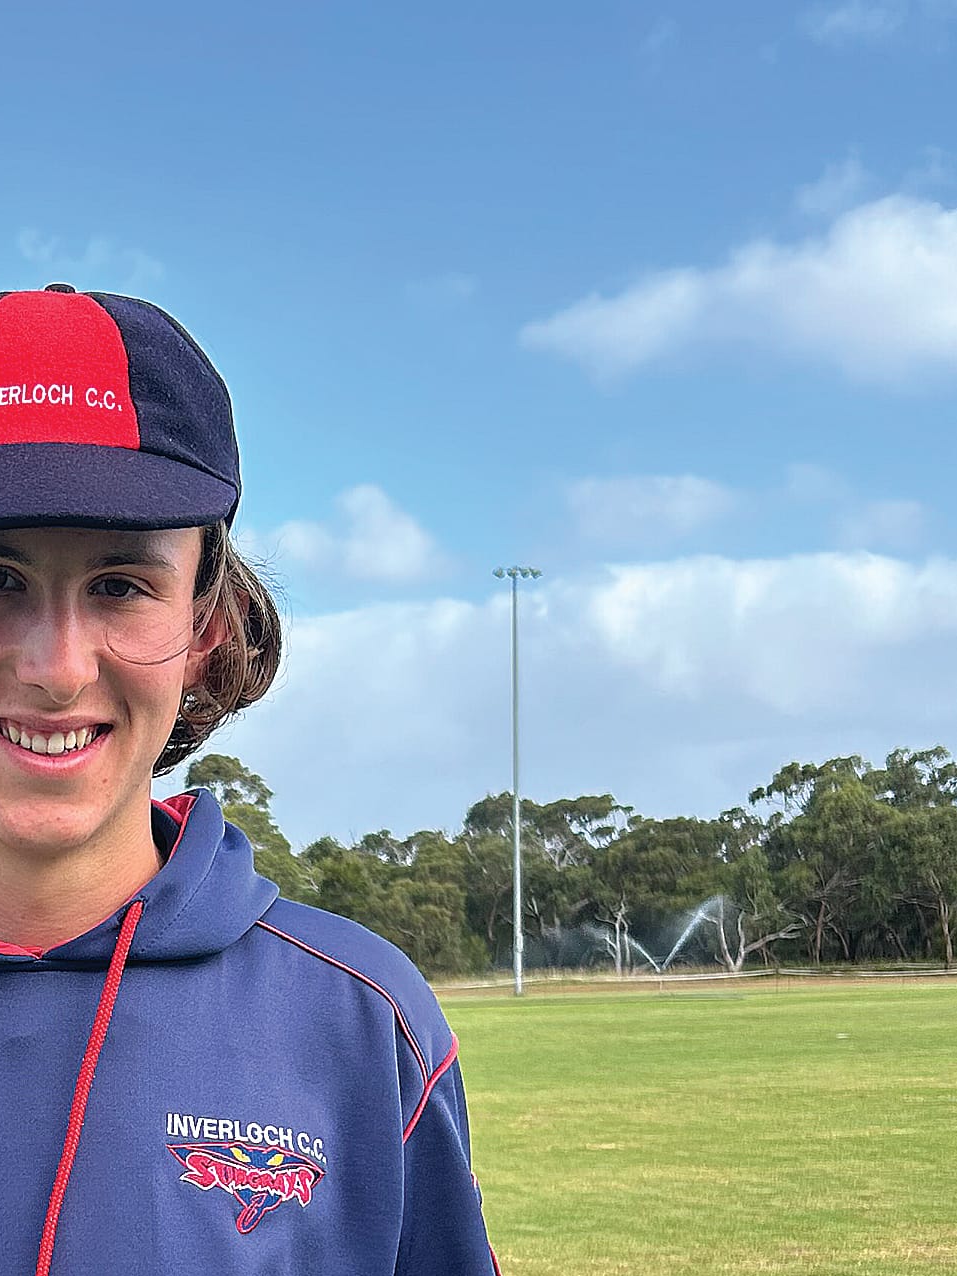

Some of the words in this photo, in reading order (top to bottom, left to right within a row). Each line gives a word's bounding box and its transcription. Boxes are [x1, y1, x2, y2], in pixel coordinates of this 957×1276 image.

[85, 387, 122, 412] C.C.
[166, 1113, 294, 1151] INVERLOCH
[297, 1133, 327, 1164] C.C.
